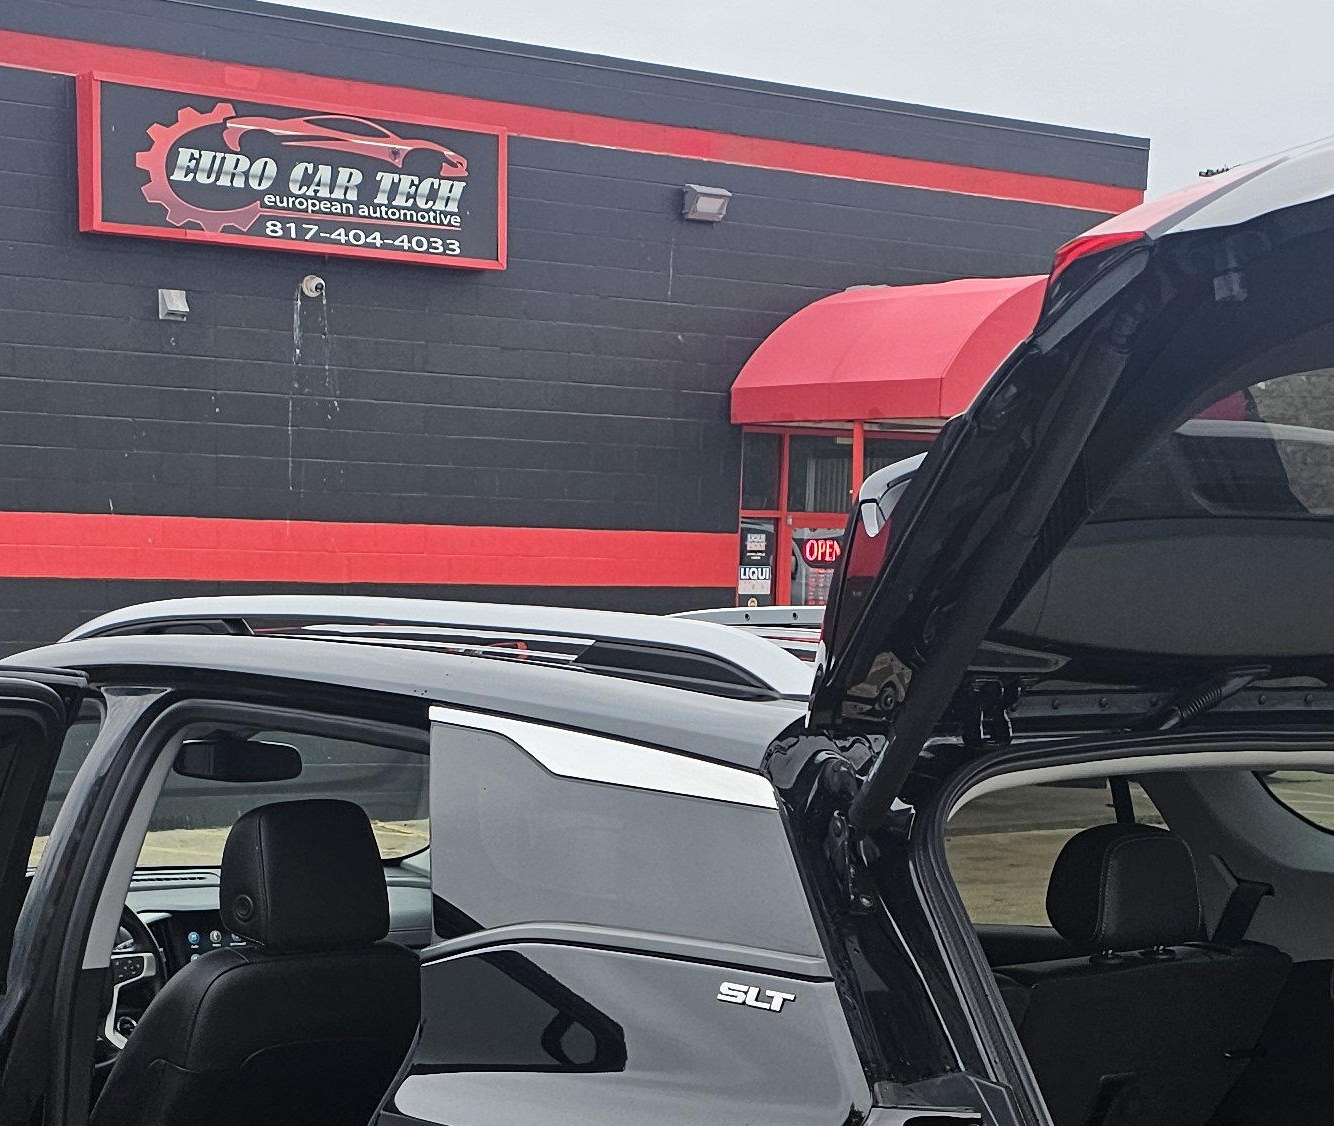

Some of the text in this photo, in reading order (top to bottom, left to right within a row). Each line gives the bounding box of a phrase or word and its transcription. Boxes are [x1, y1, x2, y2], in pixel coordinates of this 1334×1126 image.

[170, 147, 467, 213] EURO CAR TECH
[264, 193, 461, 228] european automotive
[265, 220, 461, 255] 817-404-4033
[805, 539, 842, 562] OPEN
[740, 567, 770, 580] LIQUI
[717, 981, 796, 1013] SLT
